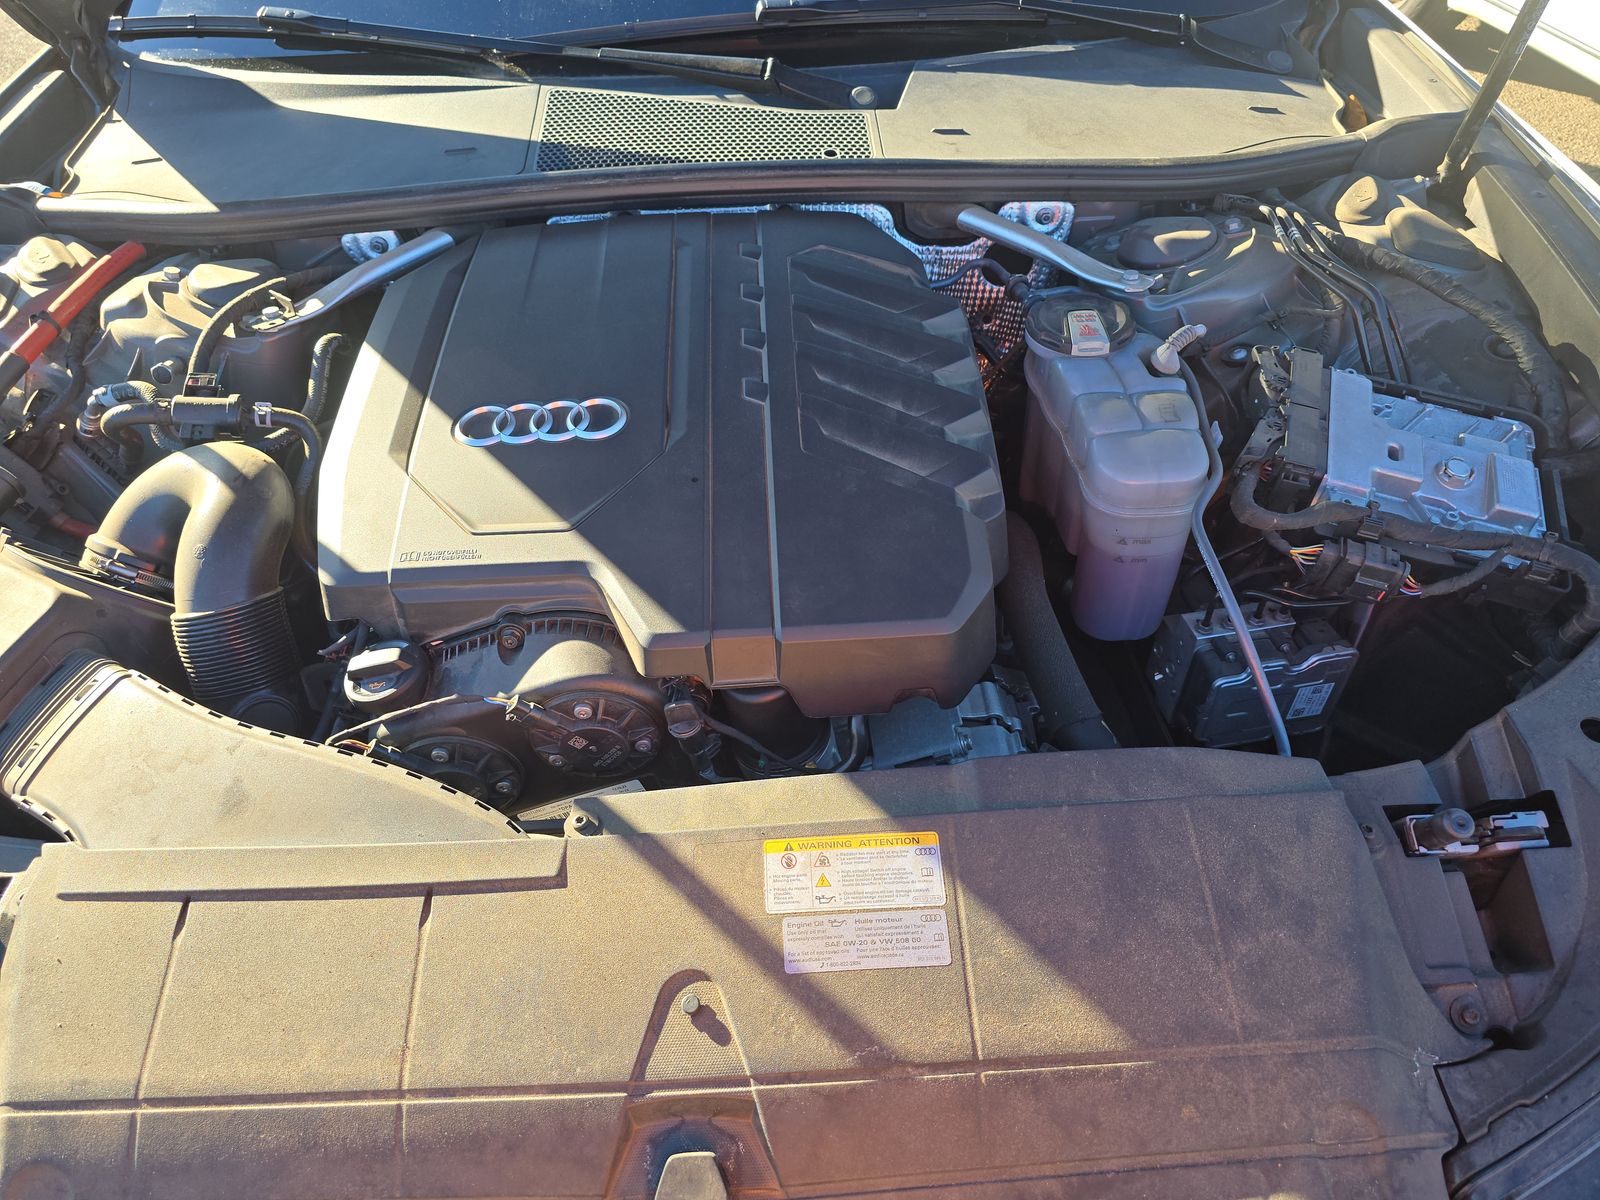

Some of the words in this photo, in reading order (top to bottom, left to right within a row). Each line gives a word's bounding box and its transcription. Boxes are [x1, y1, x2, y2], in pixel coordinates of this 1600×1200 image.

[798, 840, 852, 850] WARNING
[858, 836, 920, 847] ATTENTION
[787, 921, 812, 929] Engine
